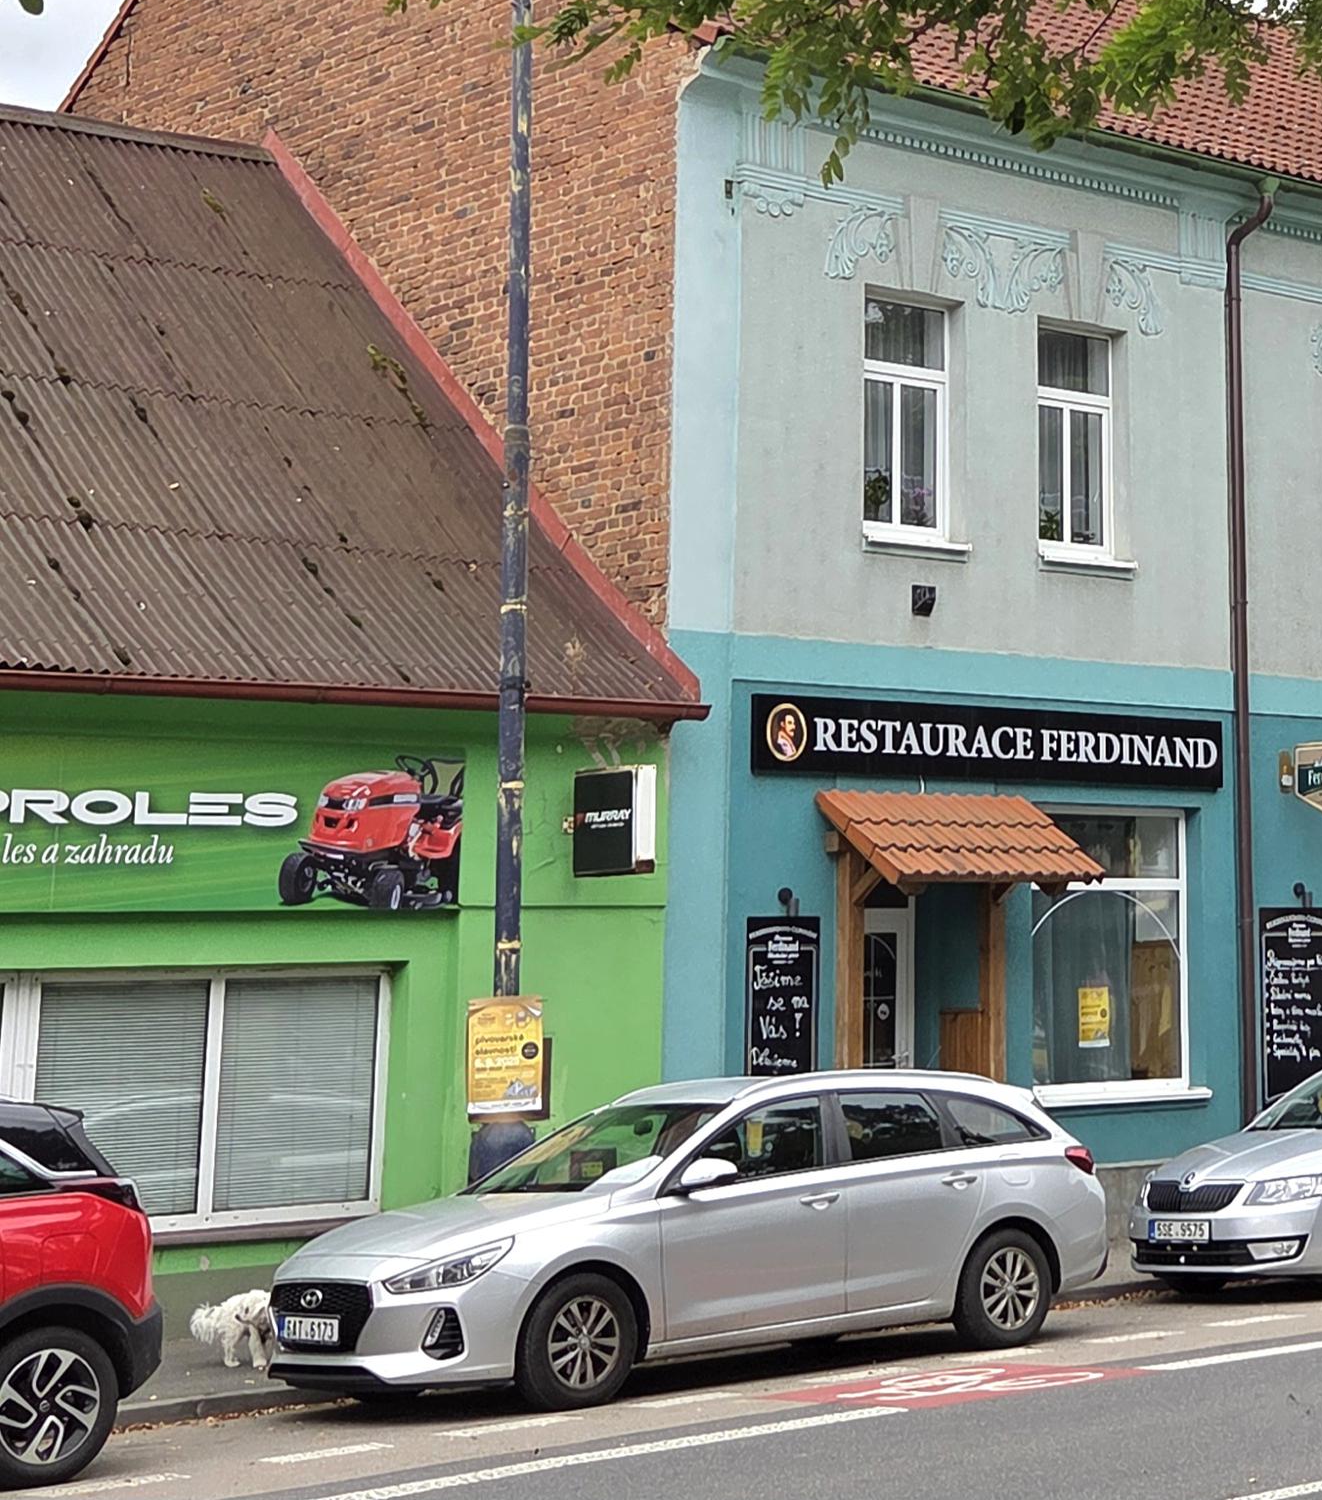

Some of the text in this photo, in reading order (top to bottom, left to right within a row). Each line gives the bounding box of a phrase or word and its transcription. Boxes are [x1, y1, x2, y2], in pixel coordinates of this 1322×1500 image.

[812, 716, 1218, 769] RESTAURACE FERDINAND
[0, 789, 298, 827] ROLES
[584, 808, 632, 823] MURRAY
[2, 833, 174, 864] les a zahradu
[766, 996, 787, 1011] se
